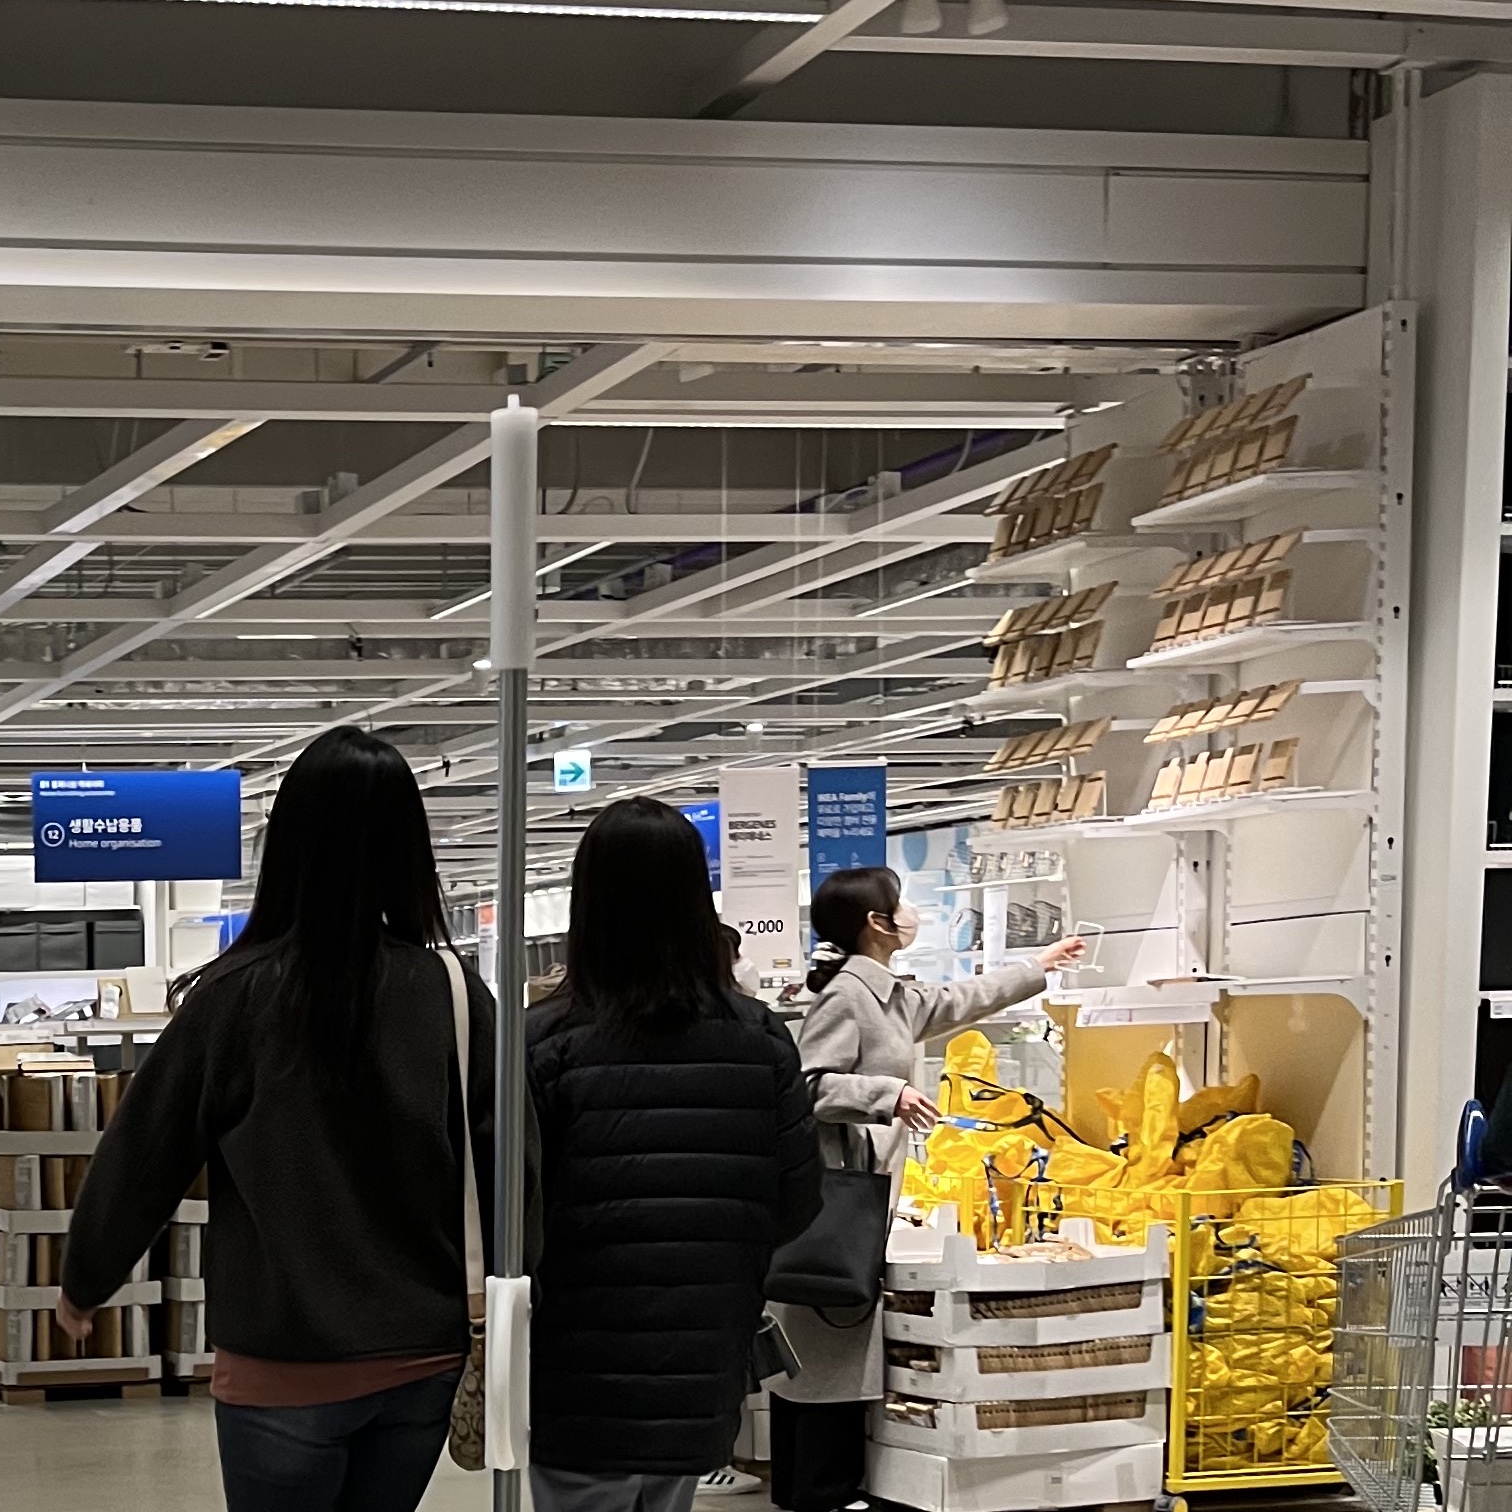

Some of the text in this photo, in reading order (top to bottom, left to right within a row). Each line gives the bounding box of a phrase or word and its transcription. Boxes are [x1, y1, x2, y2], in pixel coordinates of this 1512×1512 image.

[69, 818, 142, 834] 생활수납용품
[48, 830, 59, 839] 12
[69, 839, 162, 850] Home organisation
